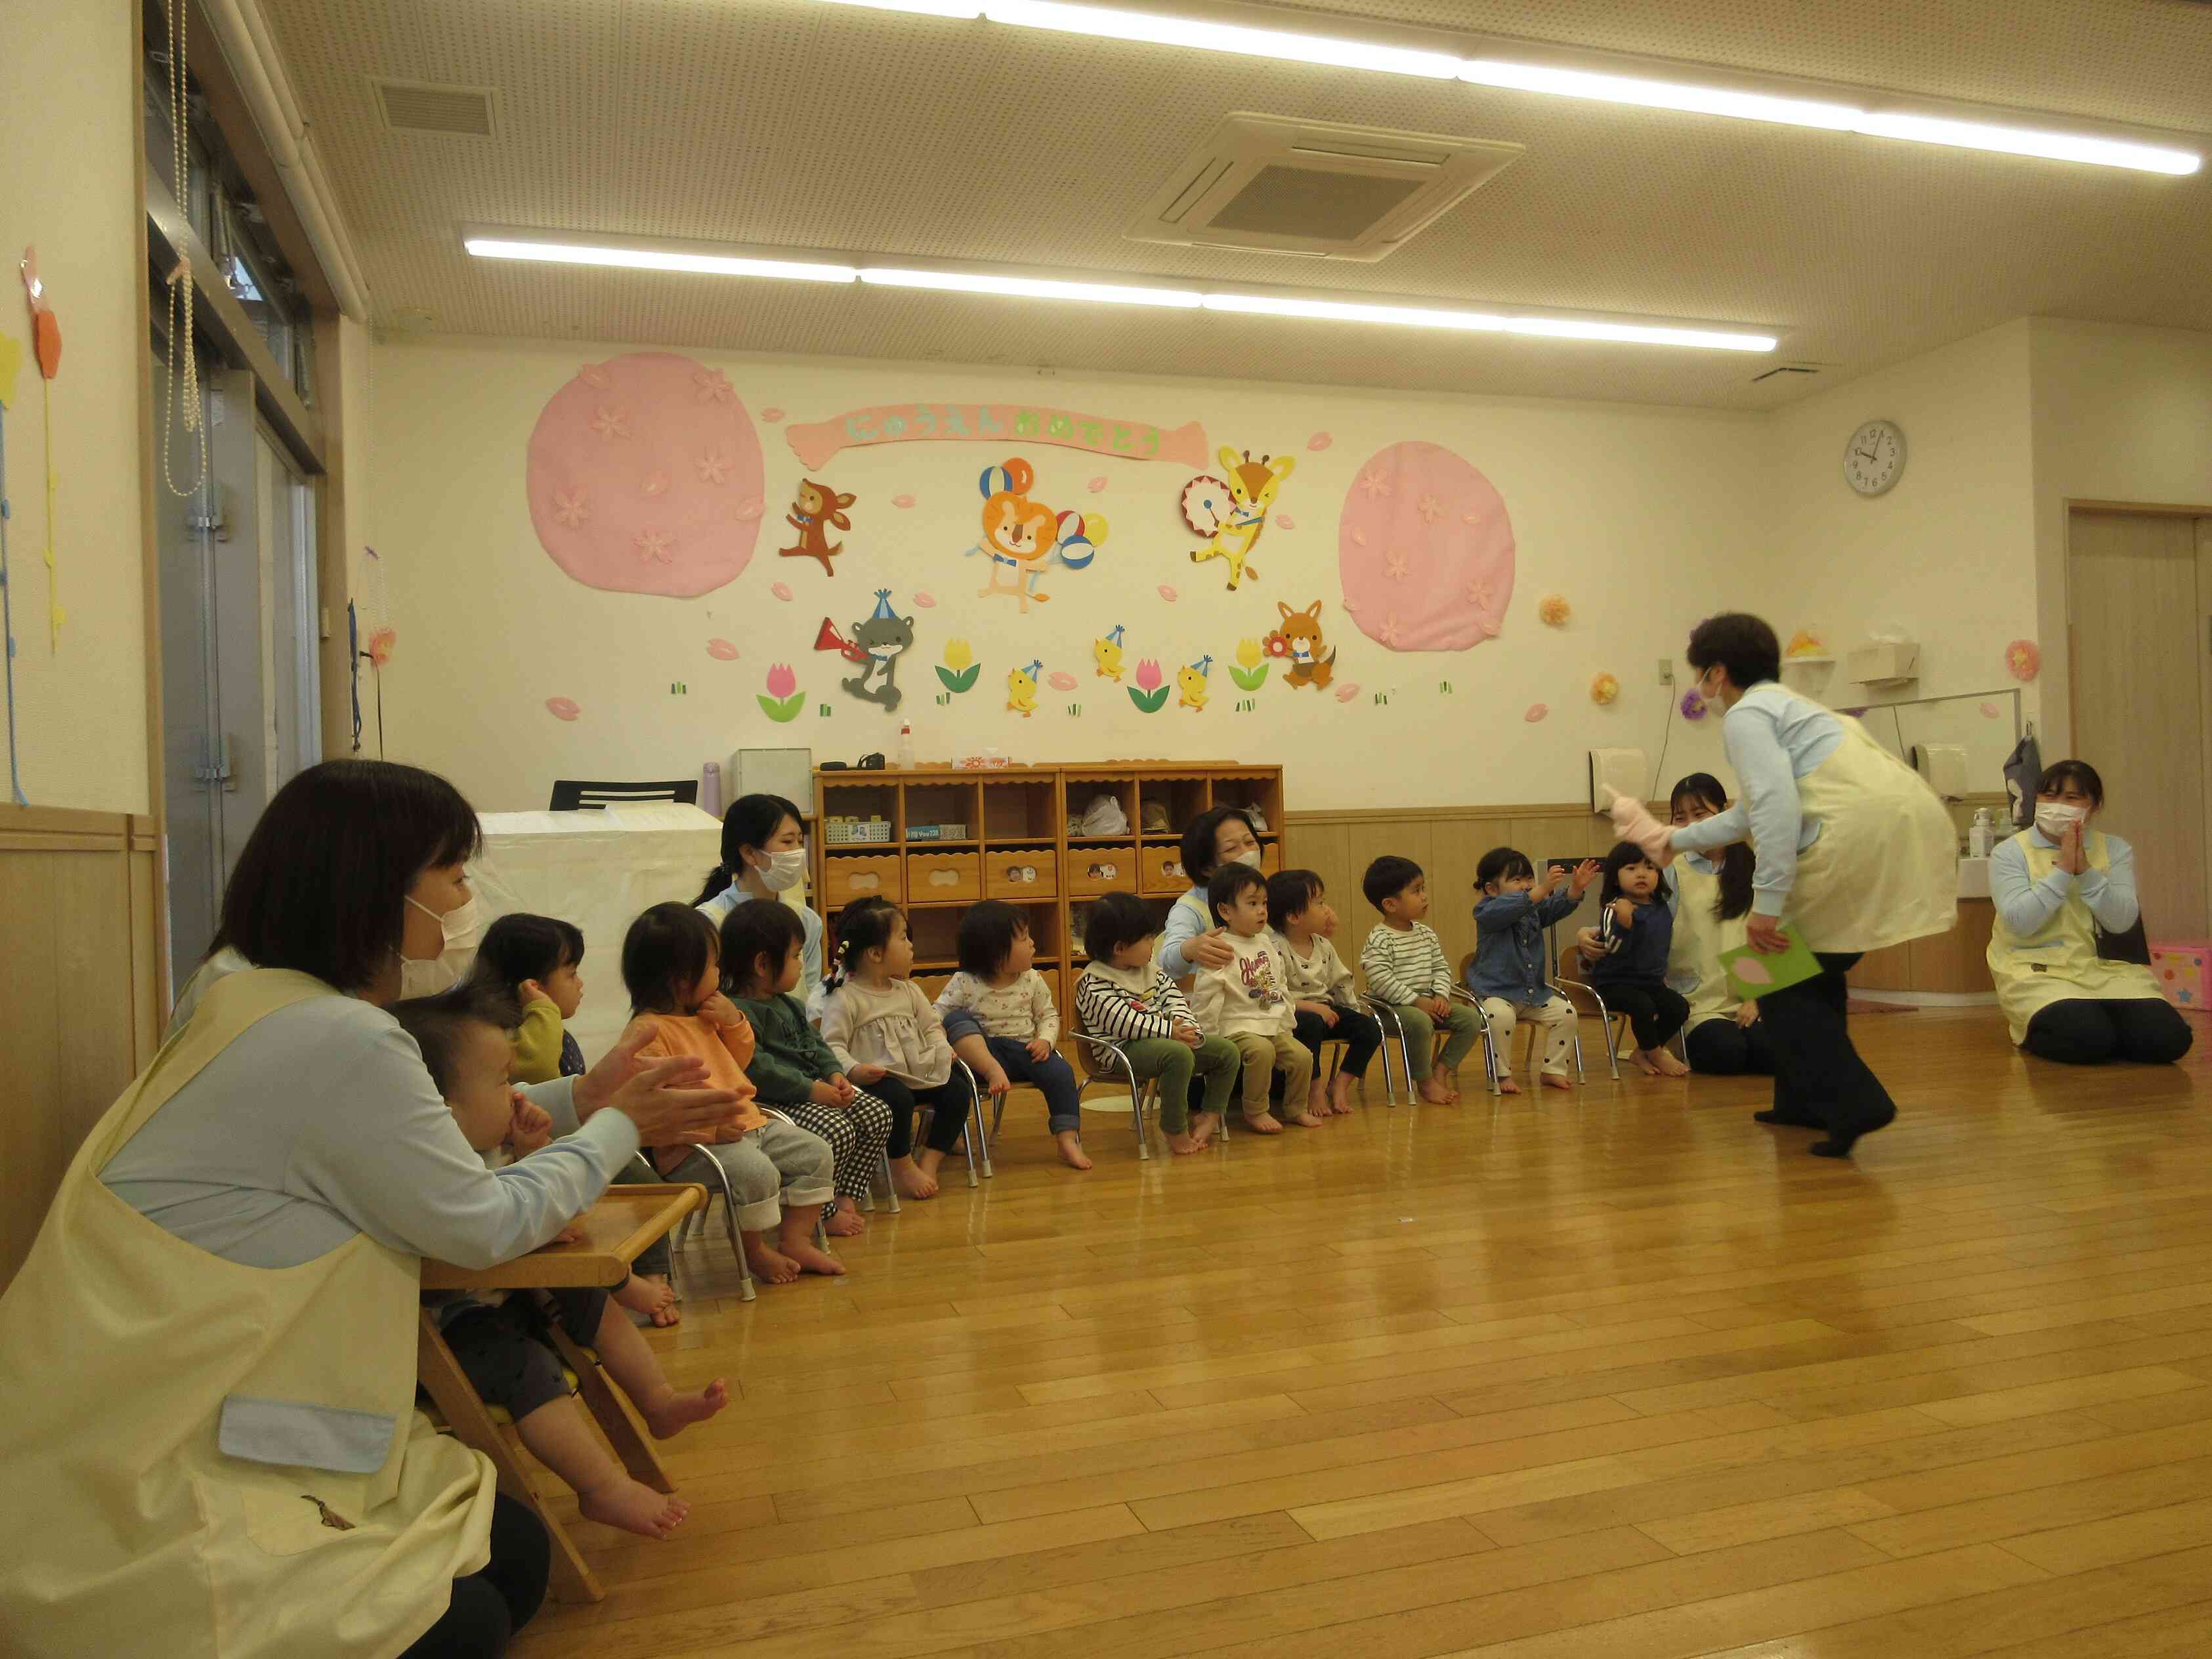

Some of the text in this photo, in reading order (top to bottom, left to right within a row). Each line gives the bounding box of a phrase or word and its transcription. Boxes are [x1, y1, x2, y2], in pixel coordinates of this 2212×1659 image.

[1886, 436, 1892, 445] 2
[1890, 448, 1896, 457] 3
[1856, 471, 1862, 480] 8
[1881, 472, 1887, 481] 5
[1863, 477, 1869, 486] 7
[1871, 478, 1878, 487] 6
